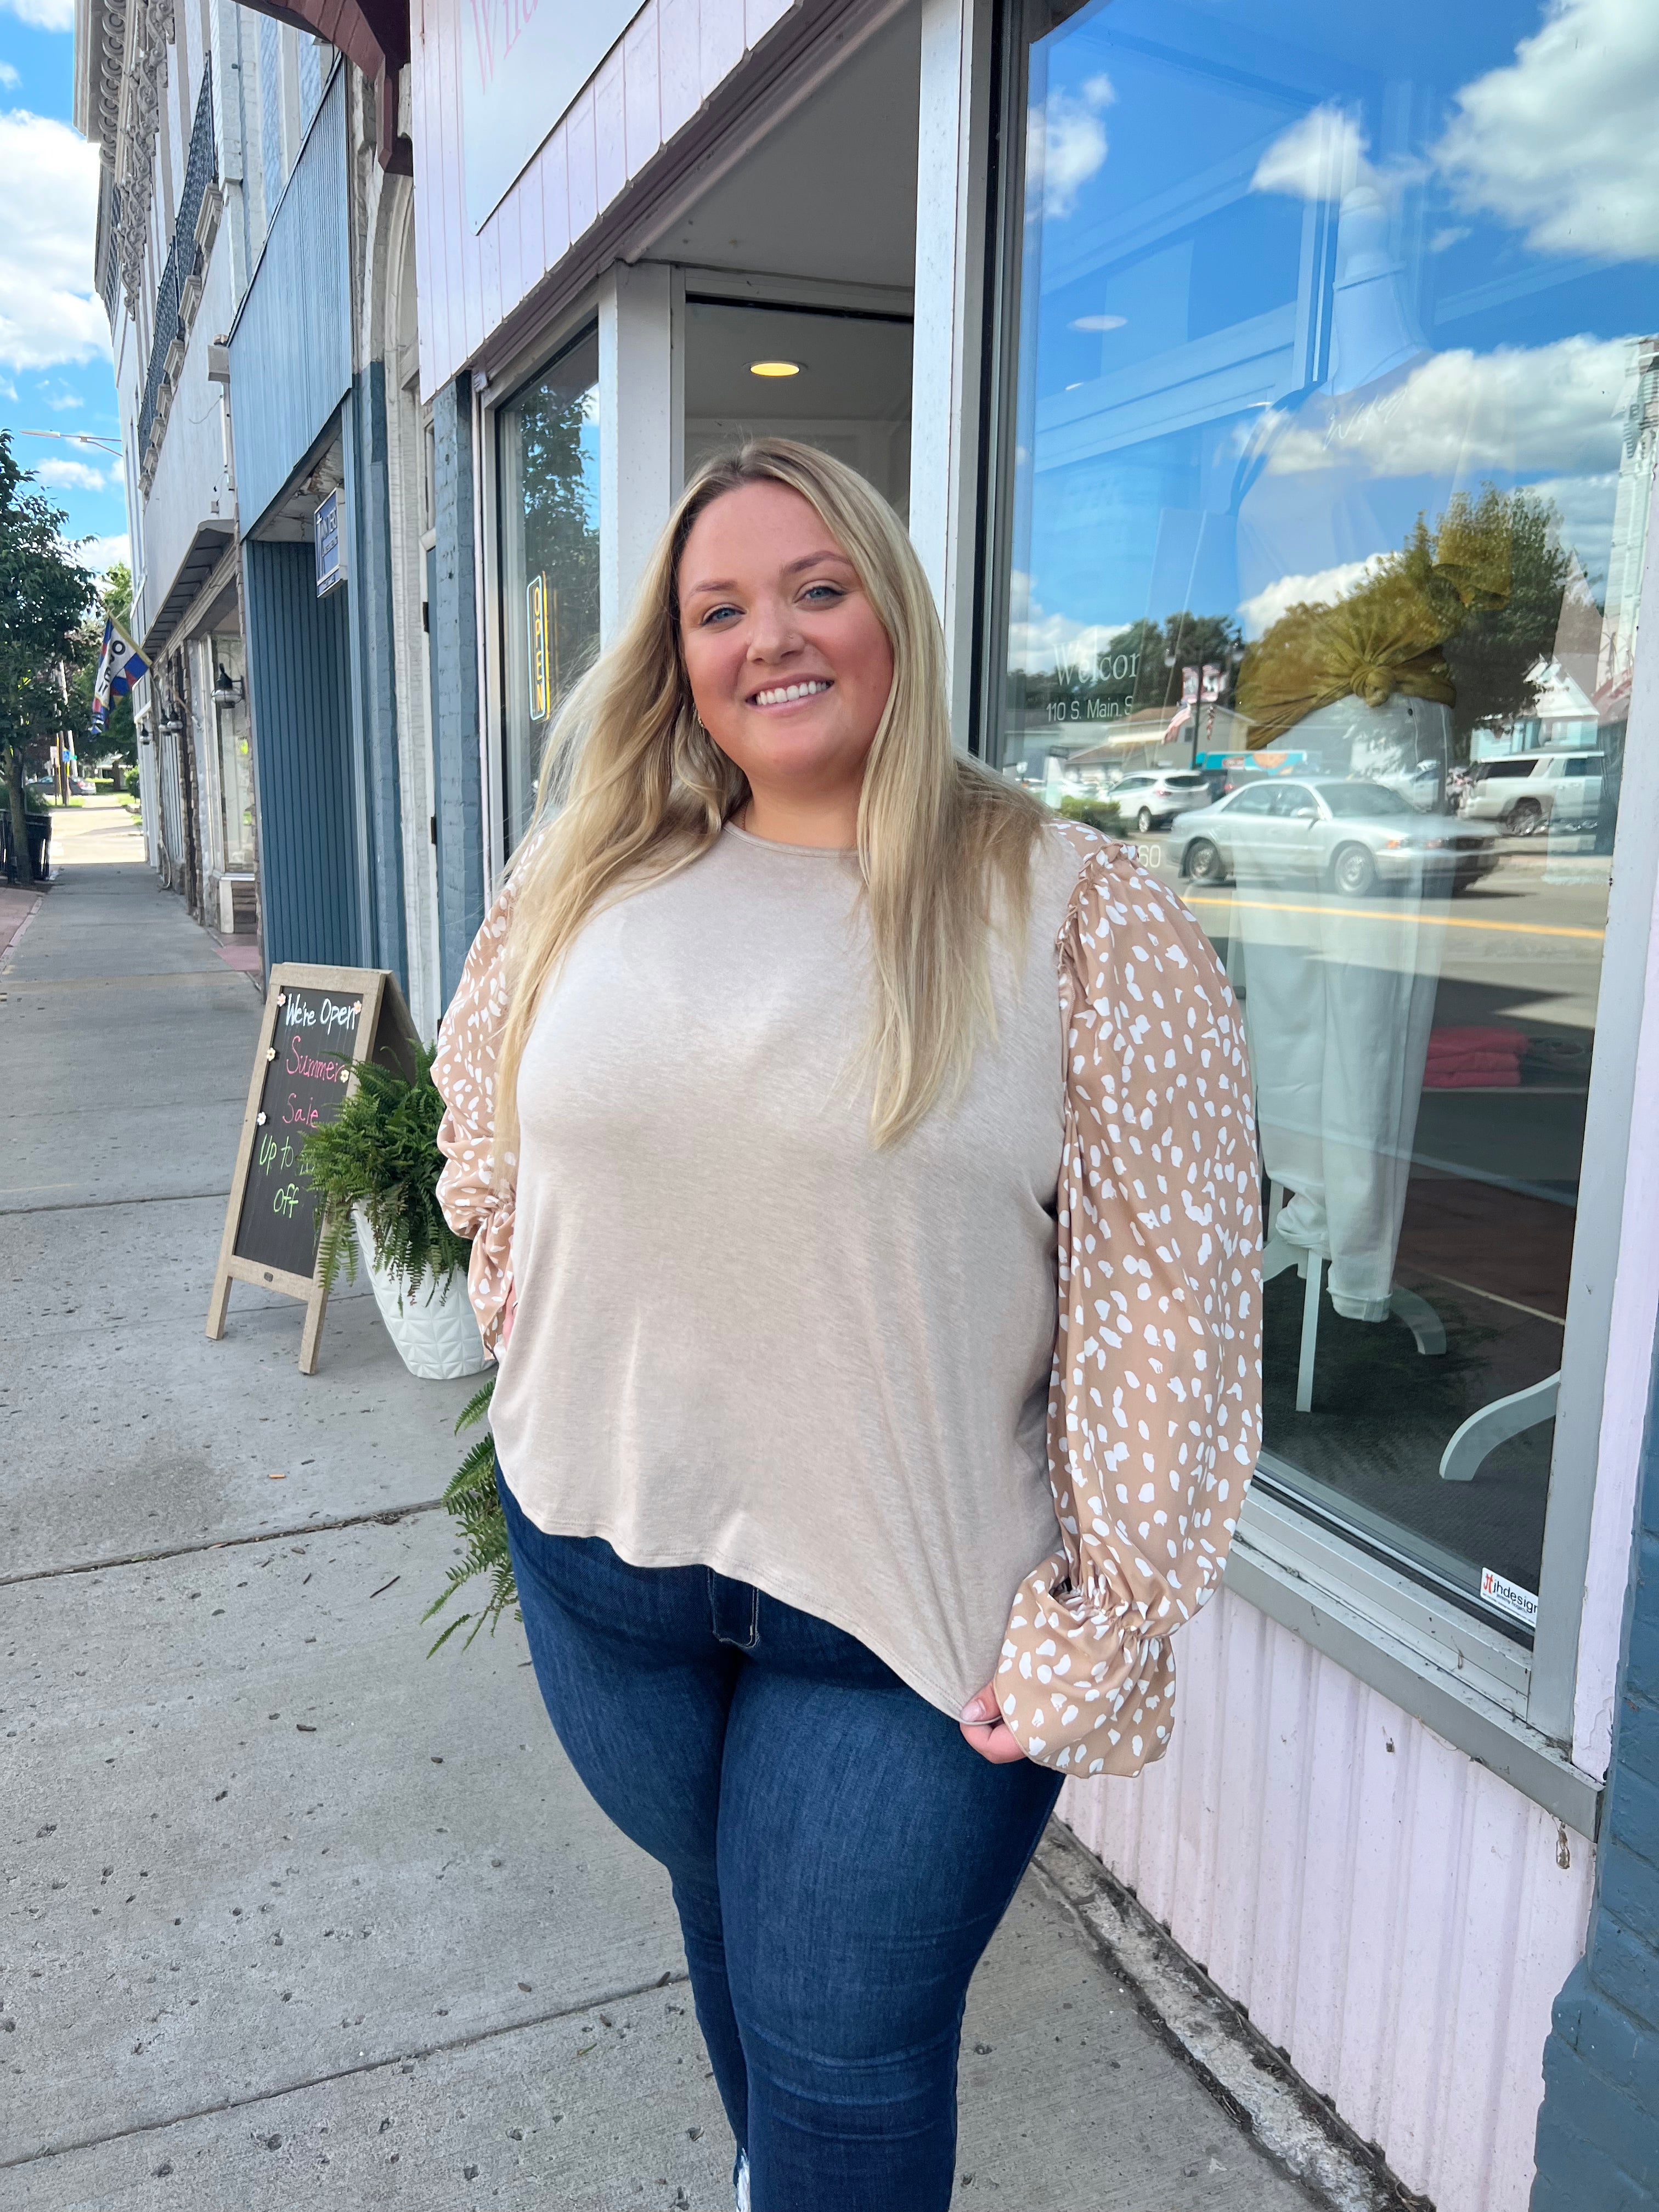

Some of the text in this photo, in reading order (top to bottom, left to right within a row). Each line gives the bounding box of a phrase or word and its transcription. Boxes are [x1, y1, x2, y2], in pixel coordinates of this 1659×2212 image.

[1046, 702, 1066, 722] 110
[1070, 701, 1081, 720] S.
[1125, 695, 1133, 716] S
[285, 993, 357, 1035] We're Open
[286, 1035, 345, 1082] Summer
[282, 1093, 319, 1128] Sale
[259, 1133, 277, 1176] Up
[280, 1136, 294, 1170] to
